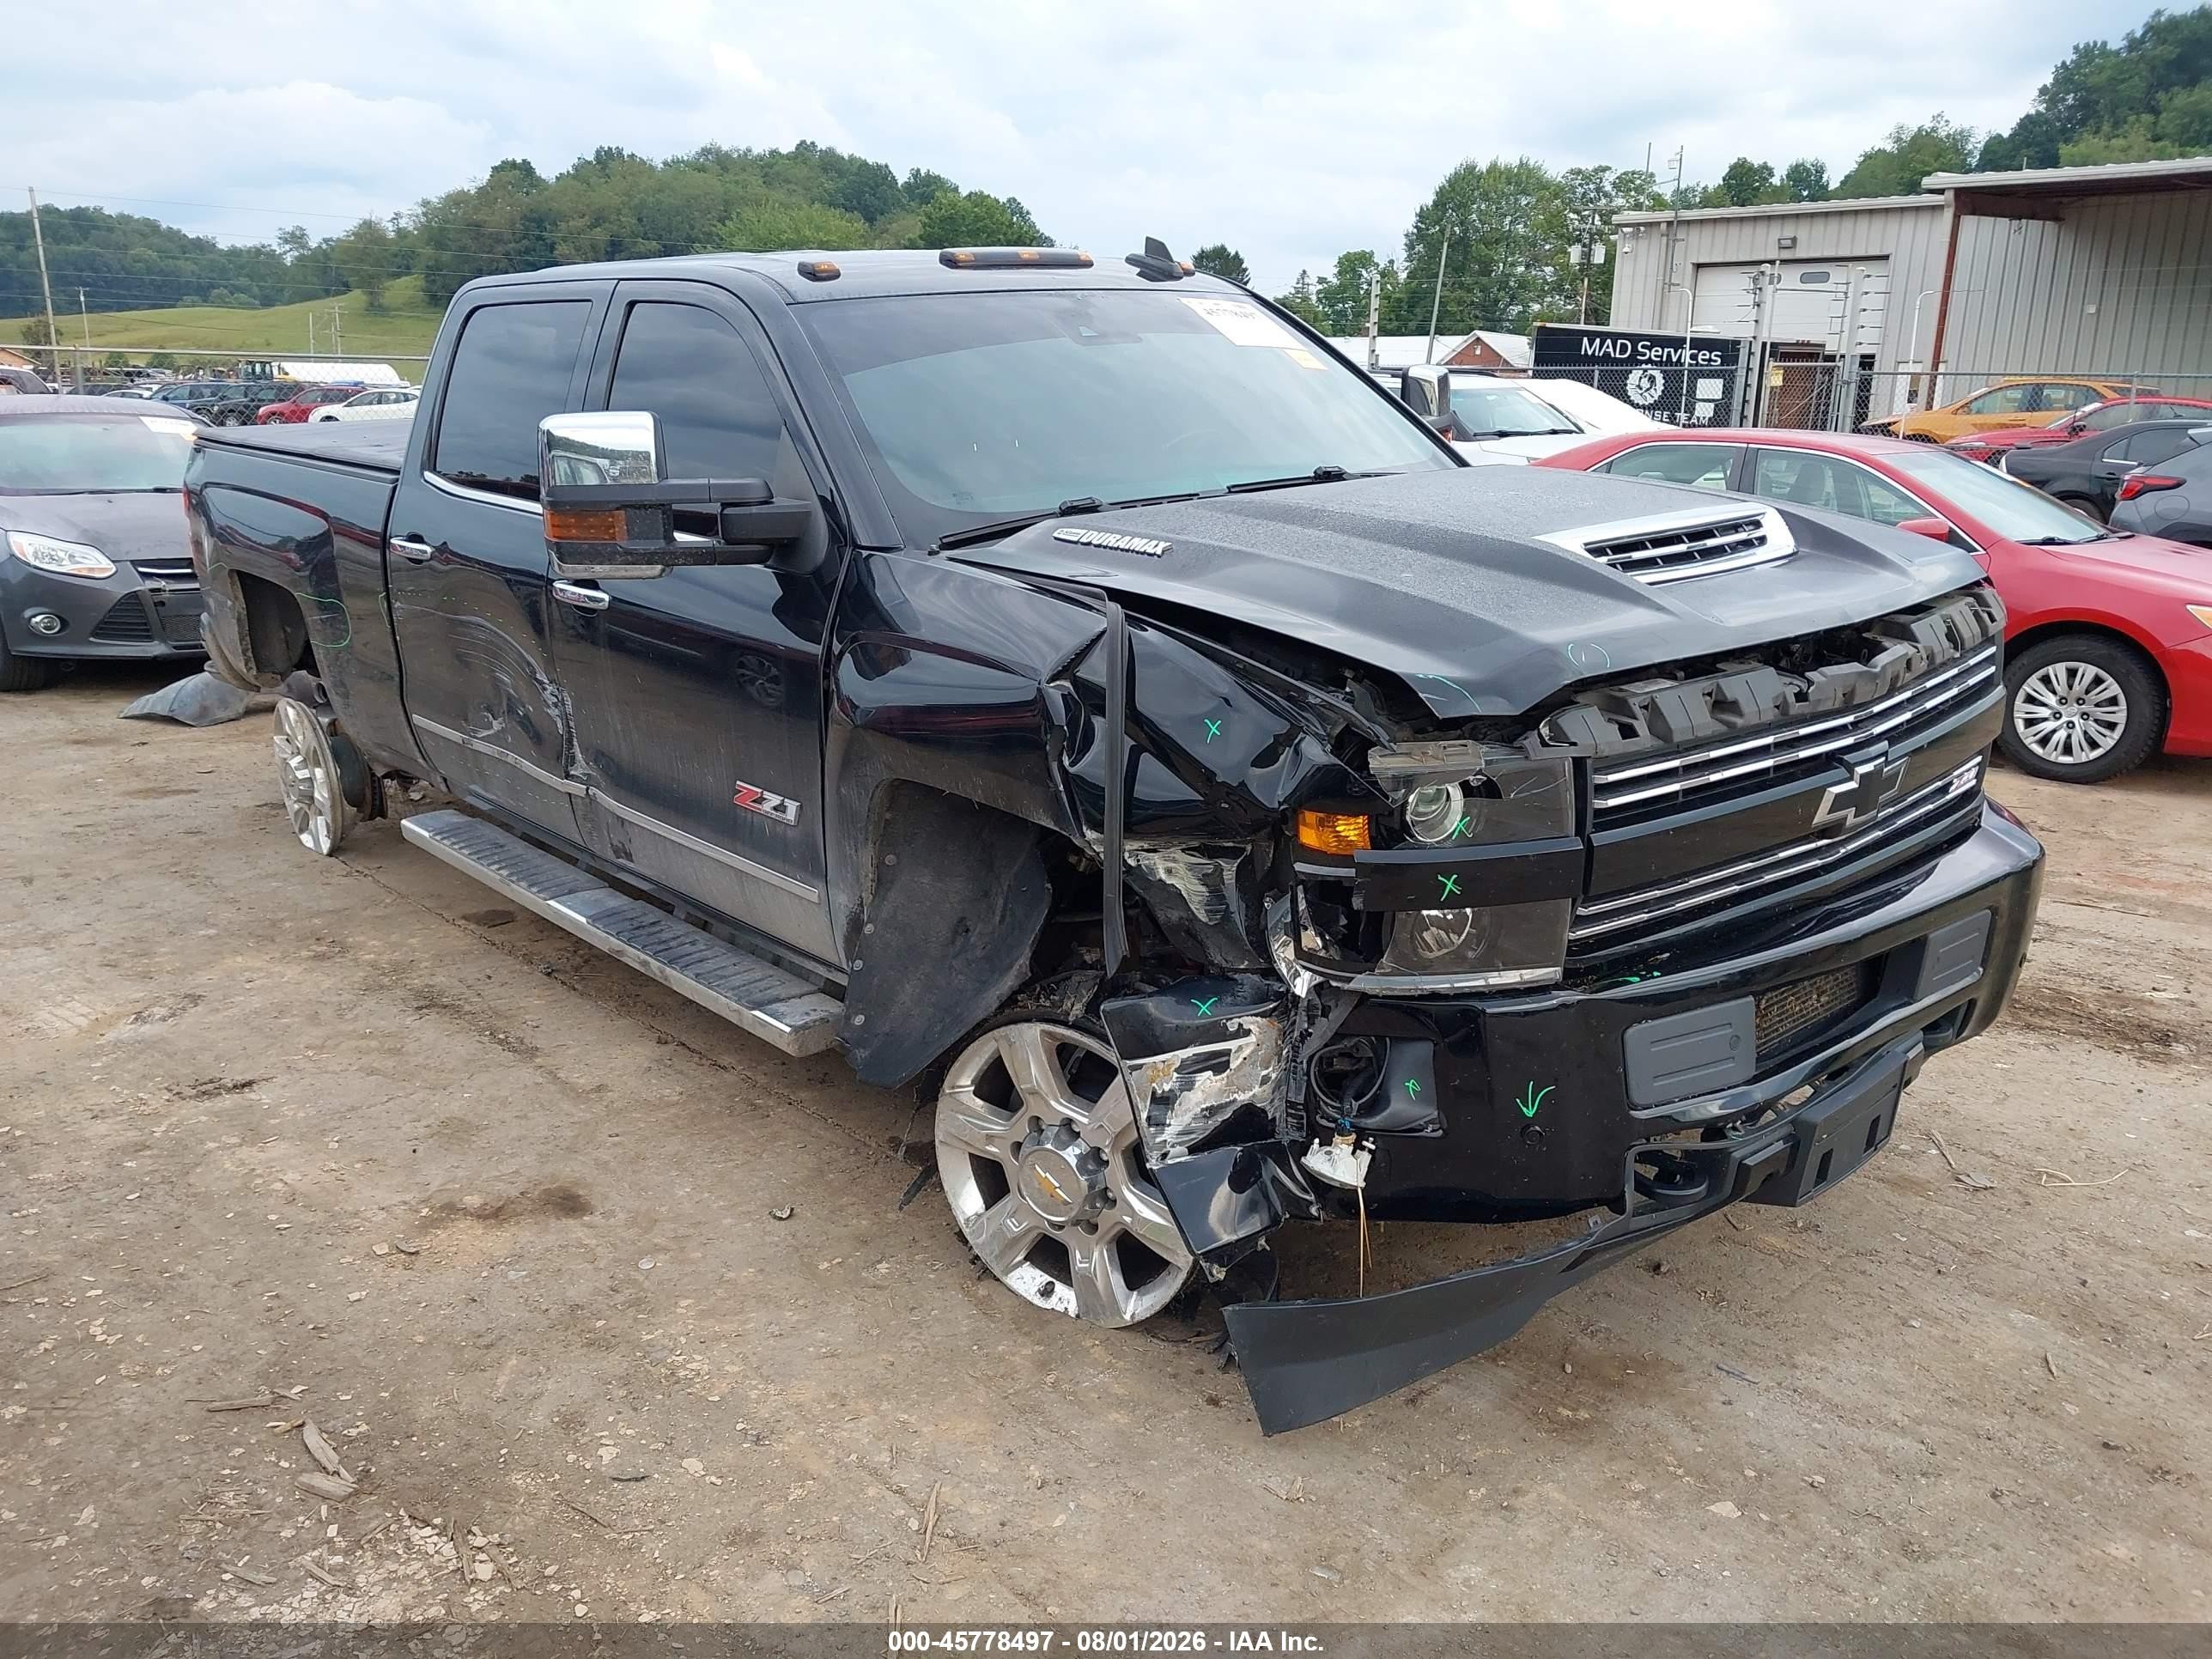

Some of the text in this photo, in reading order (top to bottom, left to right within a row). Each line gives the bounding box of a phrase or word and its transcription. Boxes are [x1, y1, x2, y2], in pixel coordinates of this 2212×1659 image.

[1581, 337, 1722, 365] MAD Services
[1674, 412, 1709, 426] TEAM
[1079, 530, 1173, 558] DURAMAX
[732, 779, 802, 826] Z71
